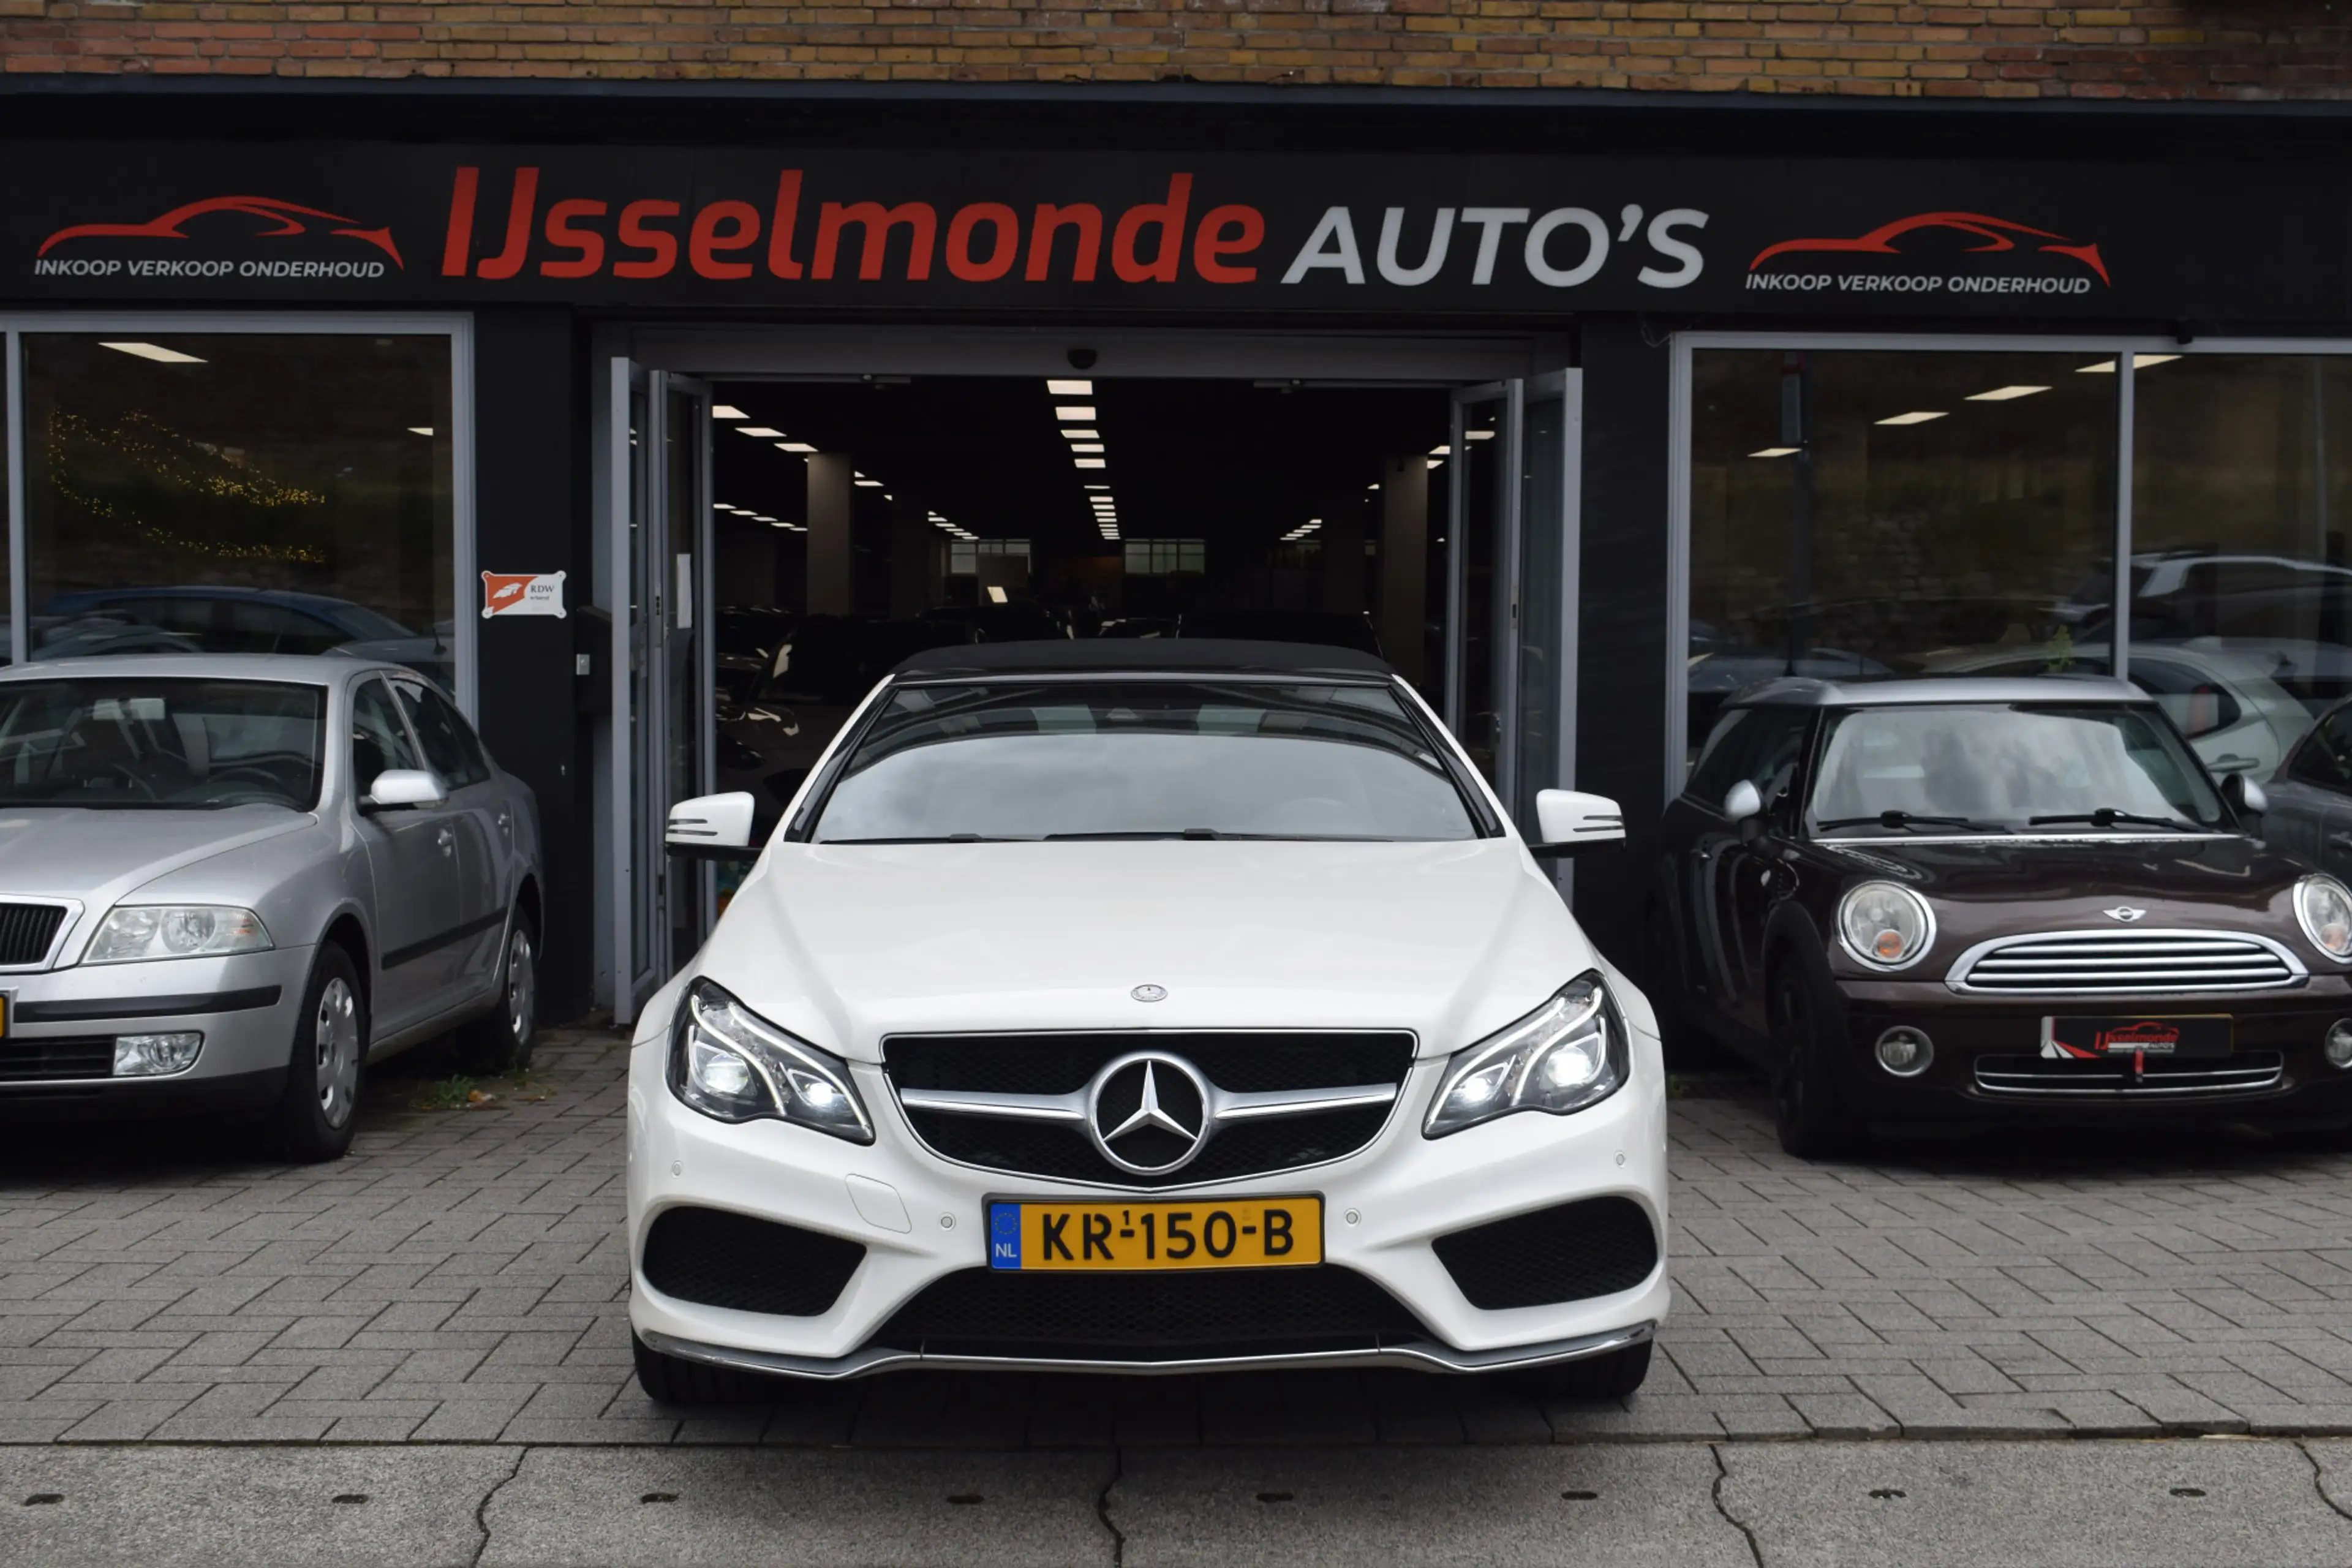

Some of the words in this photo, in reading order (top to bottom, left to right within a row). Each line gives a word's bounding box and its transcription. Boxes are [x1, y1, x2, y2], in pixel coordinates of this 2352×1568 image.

[442, 167, 1265, 284] IJsselmonde
[1280, 204, 1709, 288] AUTO'S
[34, 259, 121, 276] INKOOP
[127, 260, 233, 277] VERKOOP
[239, 261, 385, 278] ONDERHOUD
[1745, 274, 1831, 291] INKOOP
[1838, 275, 1942, 292] VERKOOP
[1948, 277, 2091, 294] ONDERHOUD
[995, 1243, 1017, 1258] NL
